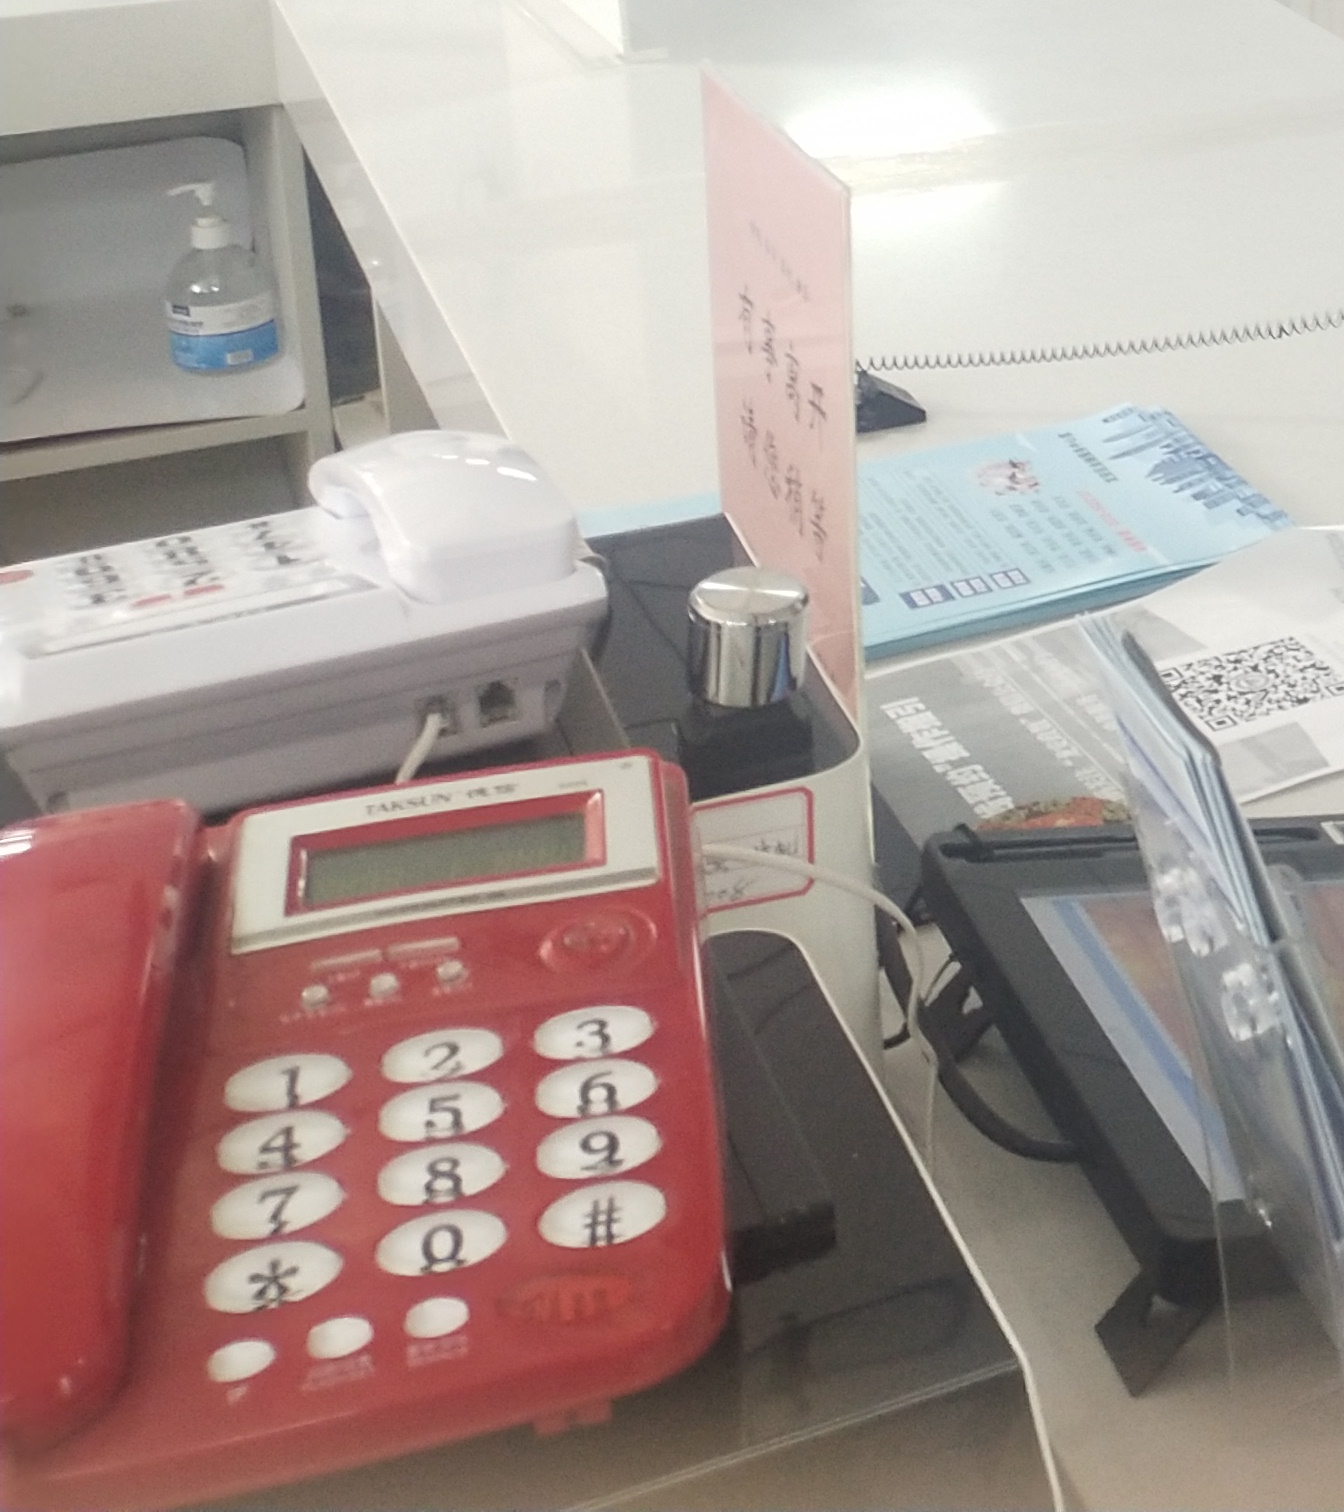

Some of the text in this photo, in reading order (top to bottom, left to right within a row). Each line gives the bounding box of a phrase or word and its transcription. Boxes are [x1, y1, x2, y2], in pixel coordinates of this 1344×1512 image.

[281, 1017, 614, 1108] 1 2 3
[256, 1071, 619, 1170] 4 5 6
[256, 1130, 624, 1234] 7 8 9
